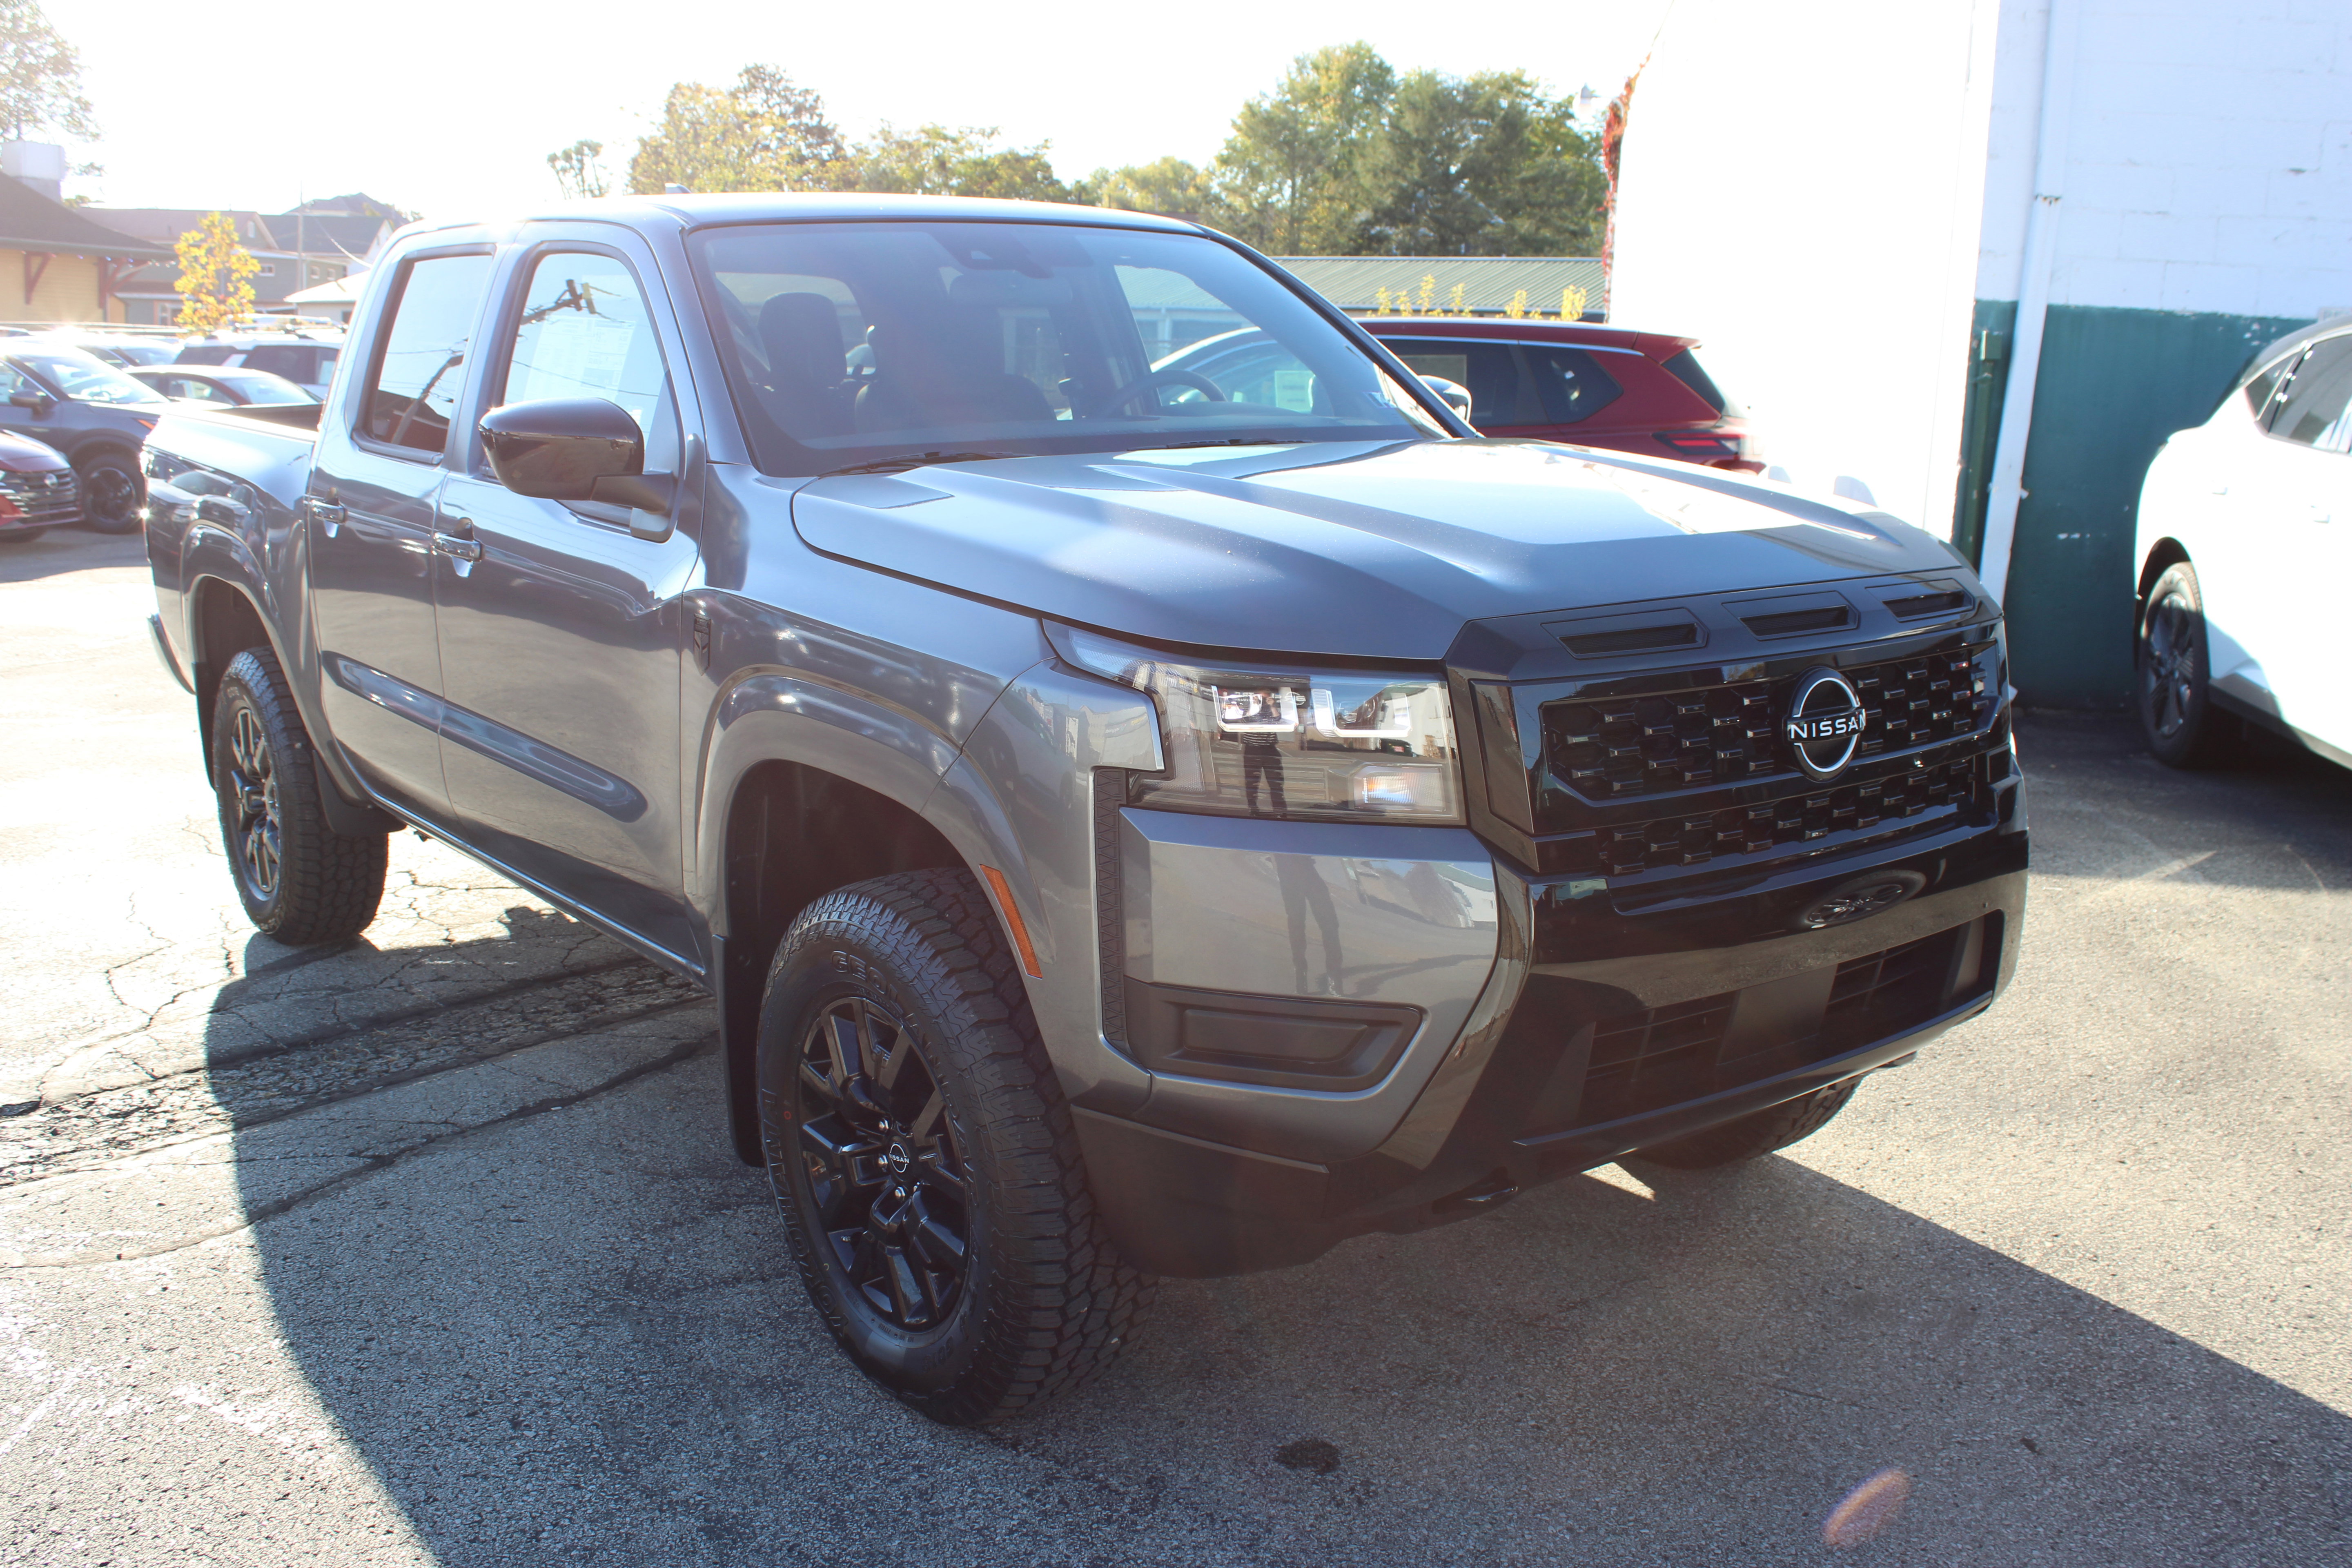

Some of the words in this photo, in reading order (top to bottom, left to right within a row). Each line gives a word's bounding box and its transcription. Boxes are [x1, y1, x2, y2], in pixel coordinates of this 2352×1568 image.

[1790, 713, 1866, 739] NISSAN
[889, 1153, 910, 1163] NISSAN
[762, 1088, 850, 1338] YOKOHAMA
